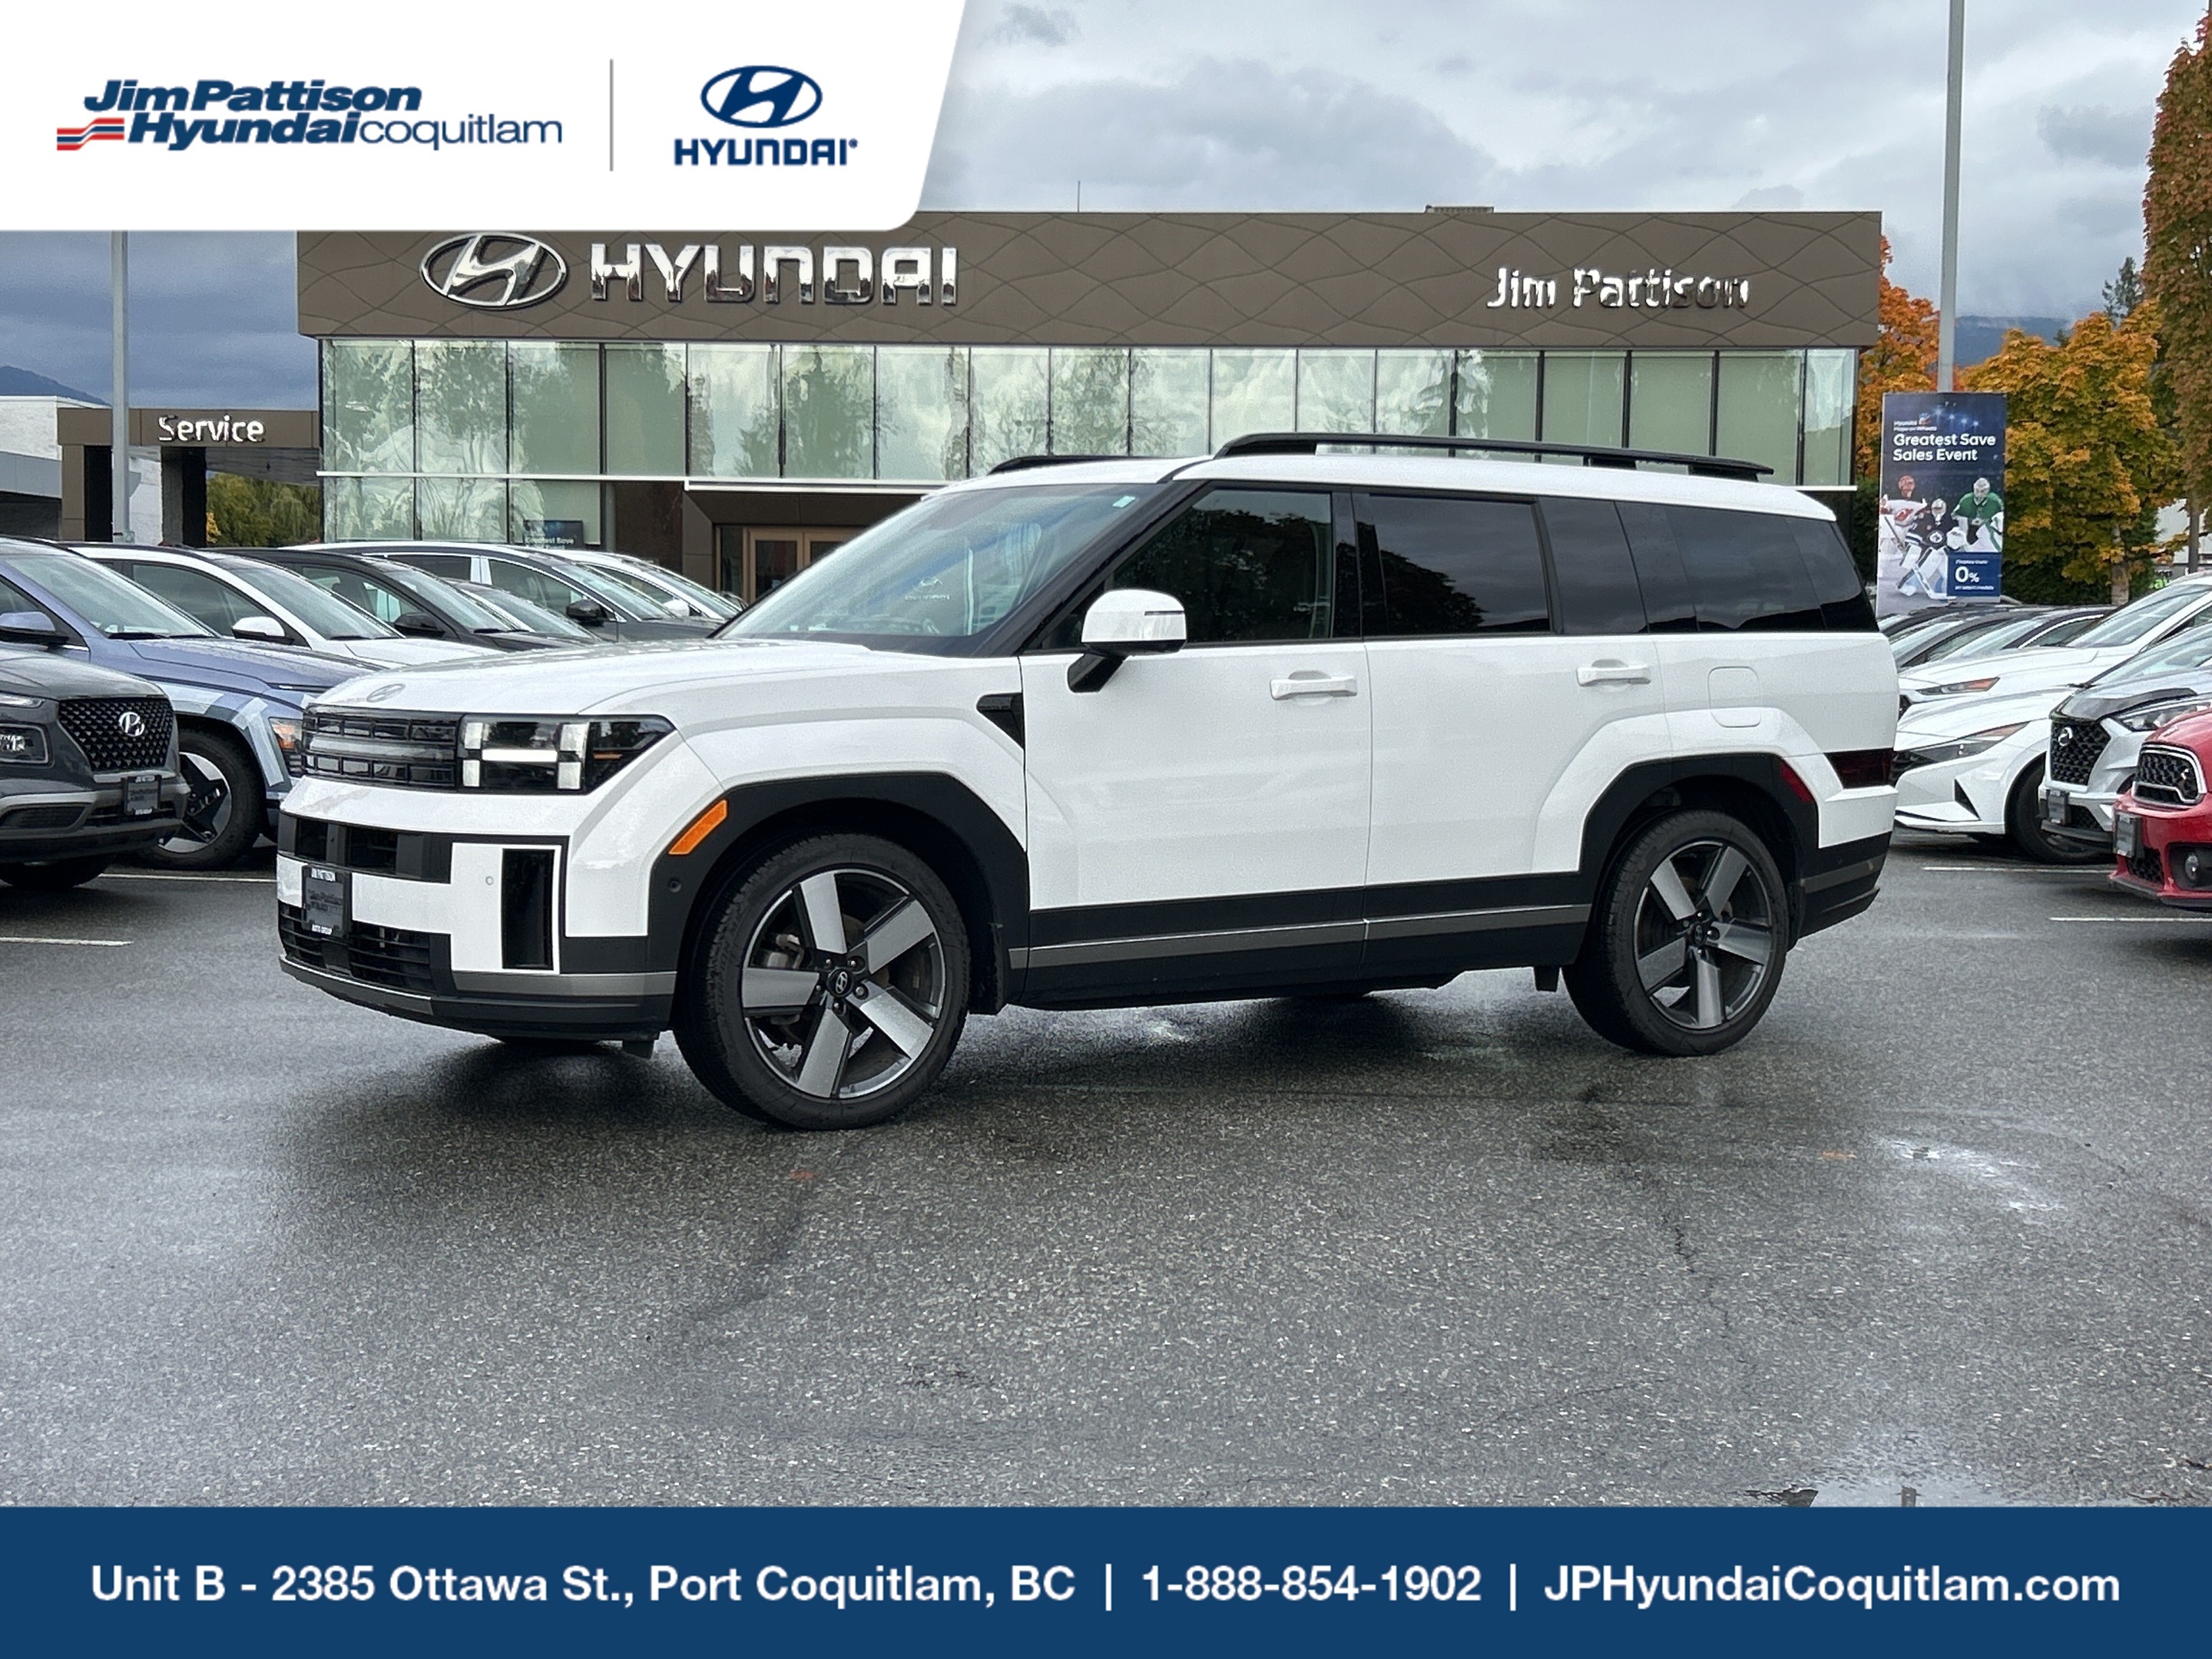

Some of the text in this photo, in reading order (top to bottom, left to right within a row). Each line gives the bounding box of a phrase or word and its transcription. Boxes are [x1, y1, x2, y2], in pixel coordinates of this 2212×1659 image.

[591, 243, 958, 305] HYUNDAI
[1486, 267, 1750, 309] Jim Pattison
[158, 414, 265, 442] Service
[1893, 433, 1997, 446] Greatest Save
[1893, 449, 1979, 462] Sales Event
[1955, 565, 1980, 583] 0%
